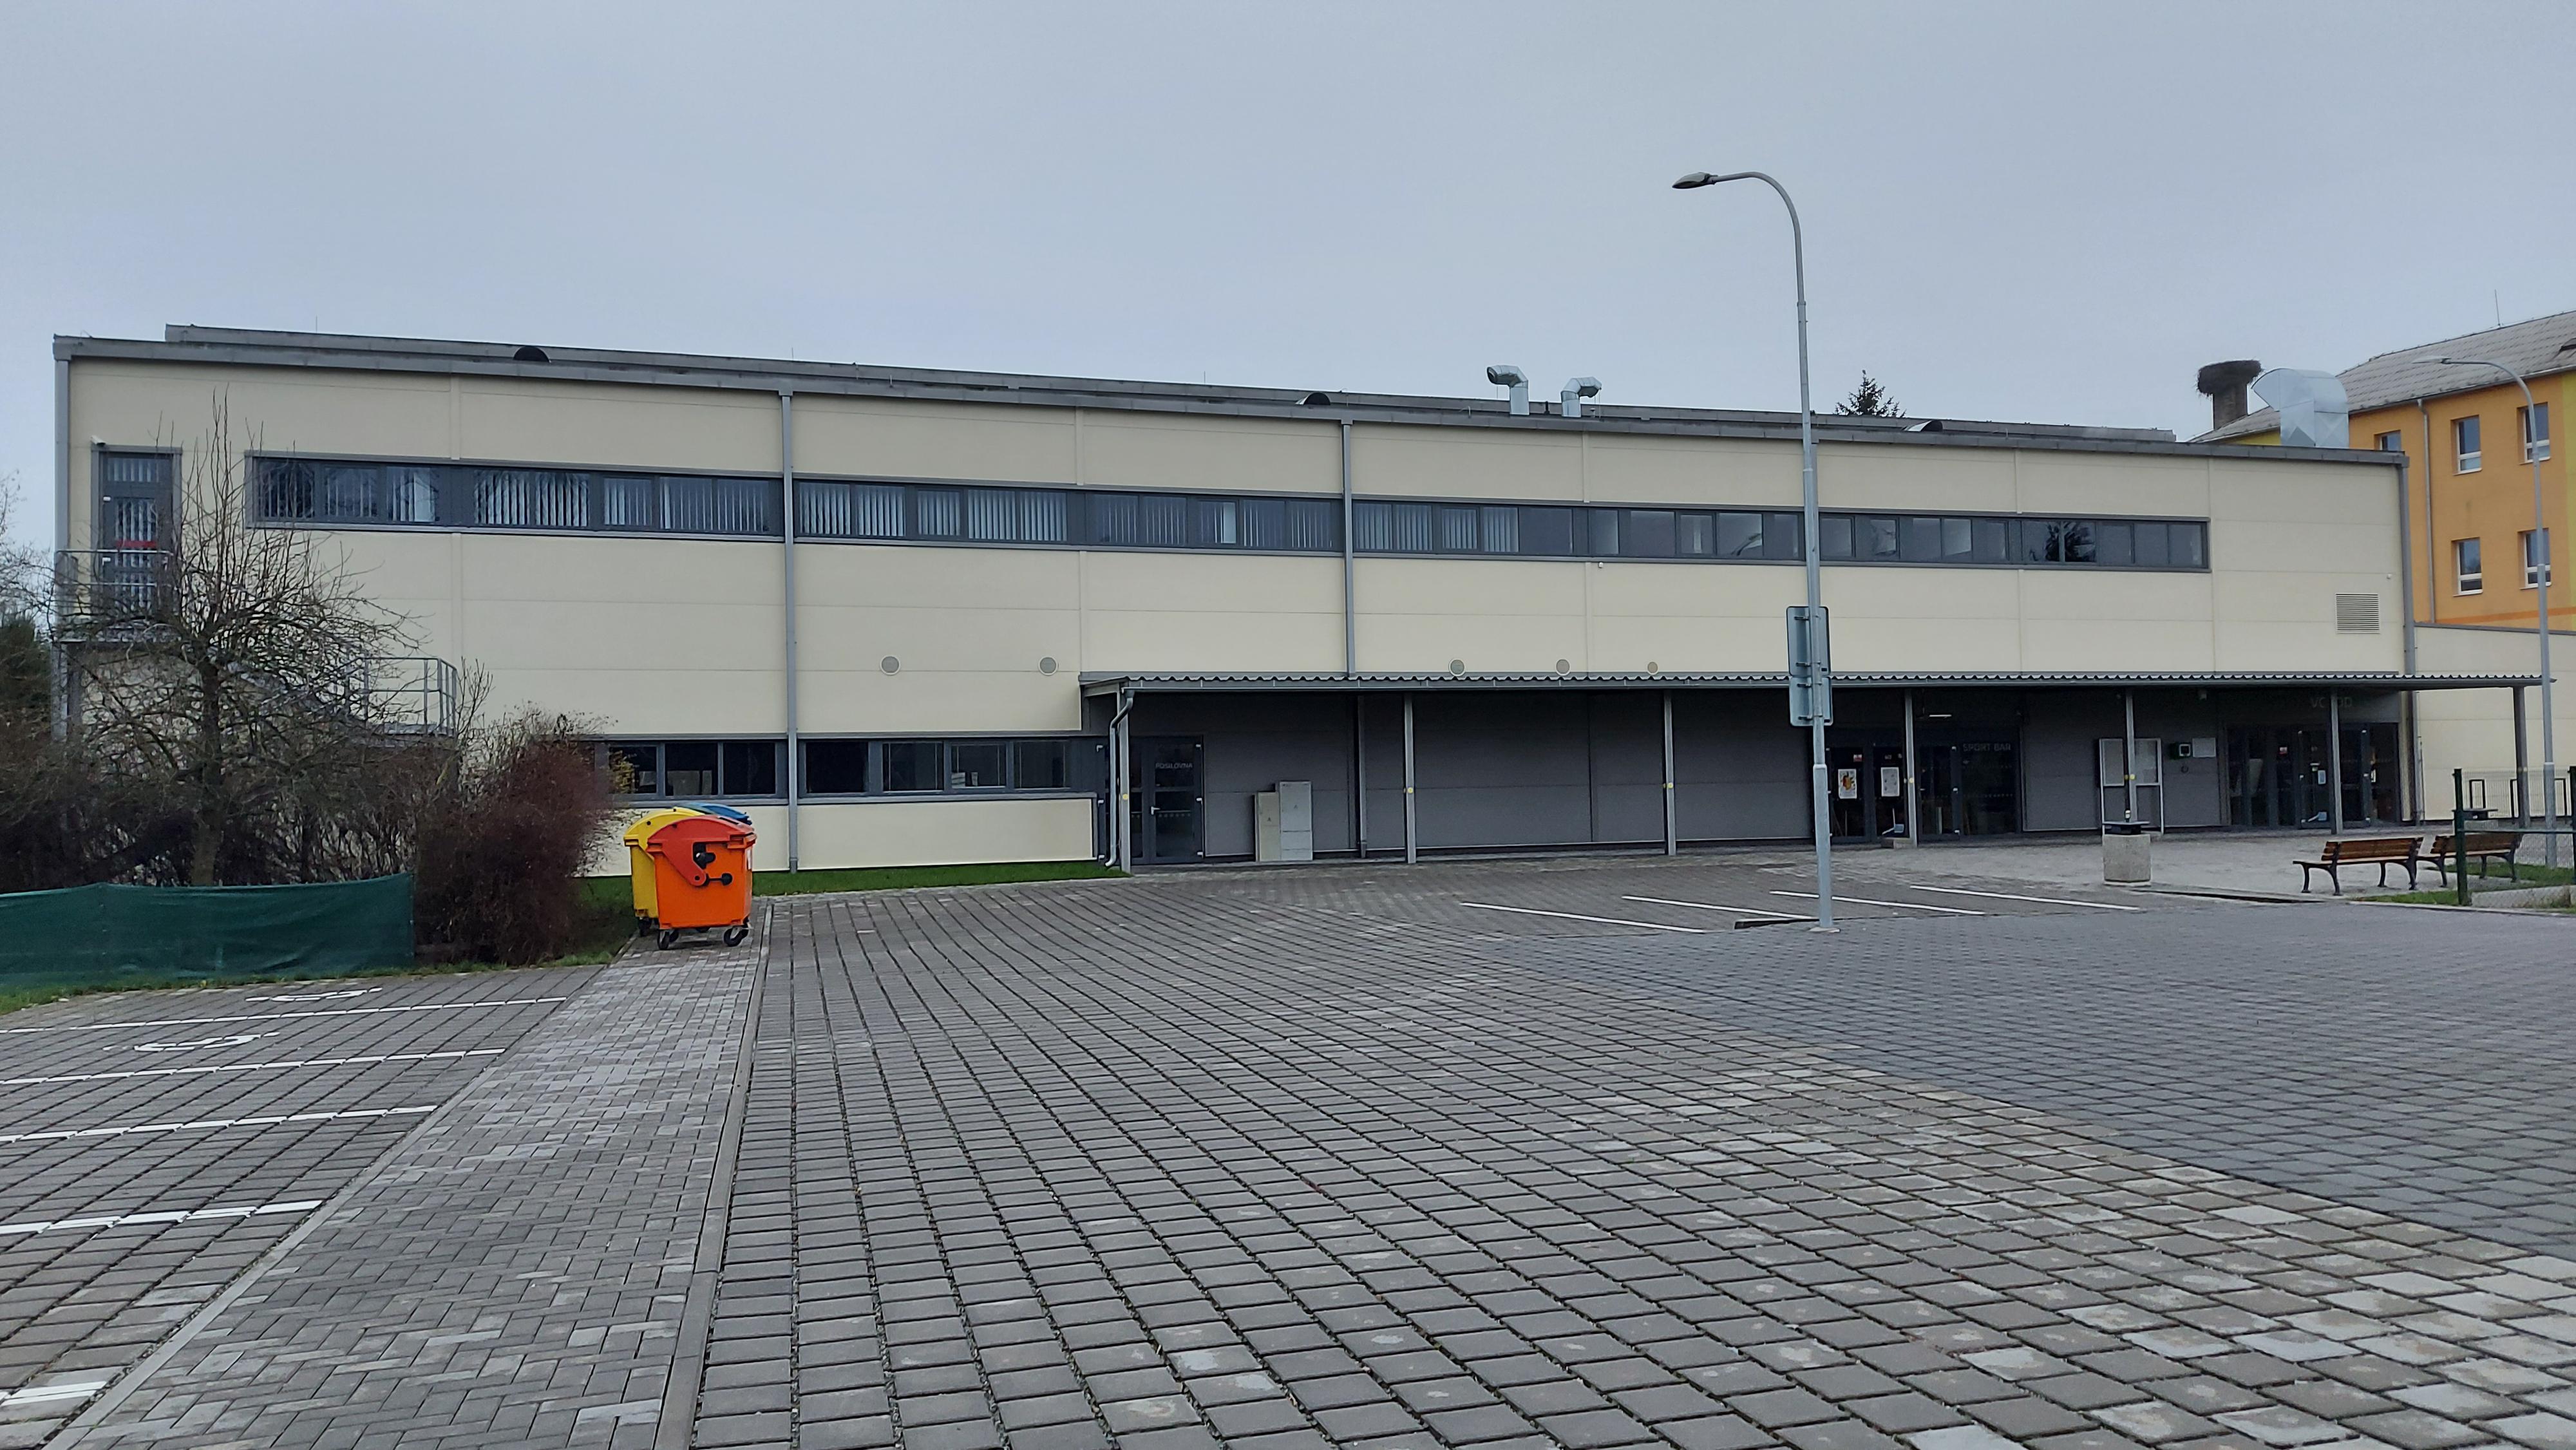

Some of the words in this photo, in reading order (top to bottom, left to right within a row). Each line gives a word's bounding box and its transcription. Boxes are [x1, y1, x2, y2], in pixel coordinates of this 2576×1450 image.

[2311, 696, 2353, 708] VCOD
[1963, 743, 1990, 752] SPORT
[1994, 743, 2011, 752] BAR
